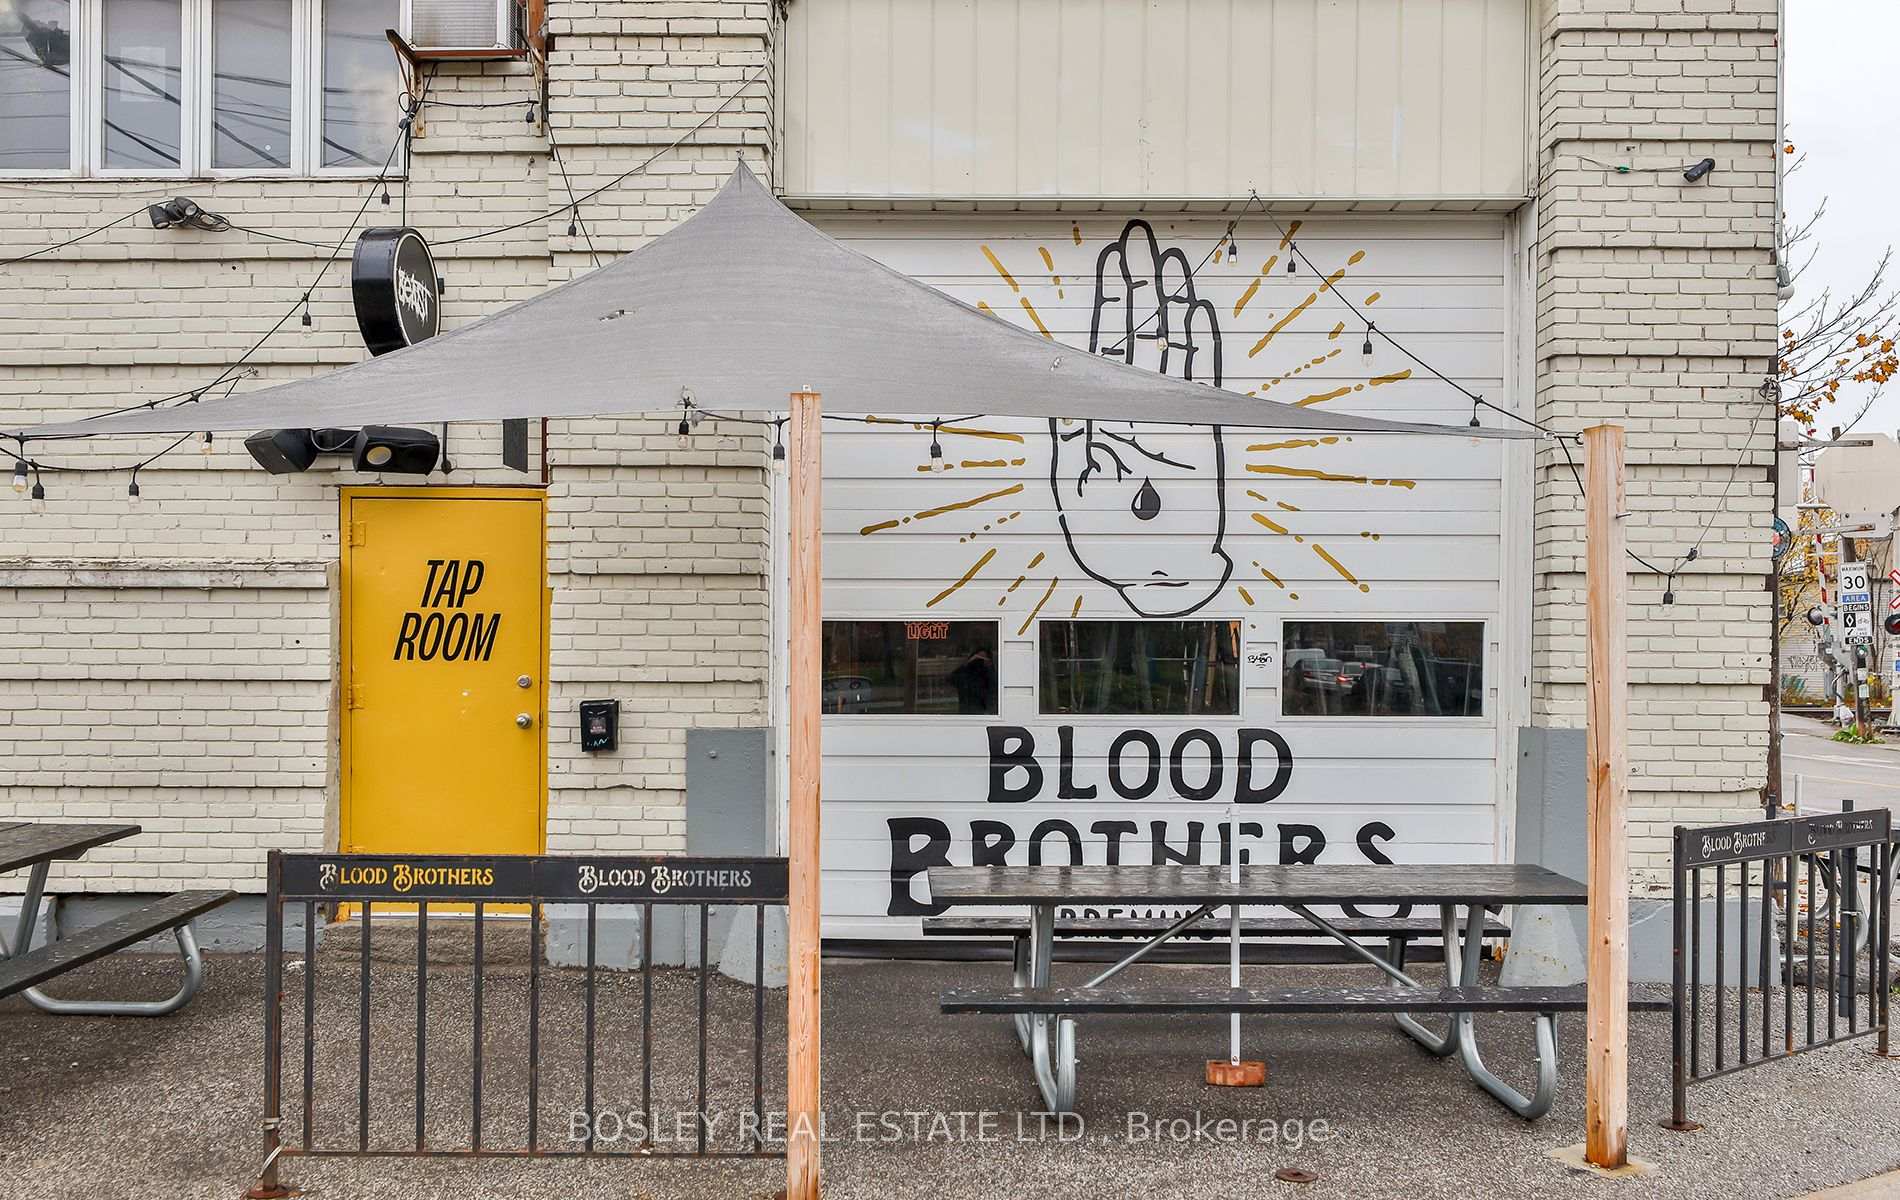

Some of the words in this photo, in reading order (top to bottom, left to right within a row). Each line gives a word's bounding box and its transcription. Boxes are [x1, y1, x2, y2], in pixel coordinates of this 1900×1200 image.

[421, 560, 485, 608] TAP
[1843, 575, 1865, 590] 30
[1843, 603, 1870, 612] BEGINS
[1845, 594, 1866, 603] AREA
[393, 612, 502, 662] ROOM
[907, 622, 949, 640] LIGHT
[1848, 636, 1870, 644] ENDS
[986, 726, 1293, 803] BLOOD
[1702, 836, 1732, 858] BLOOD
[319, 864, 388, 891] BLOOD
[393, 864, 495, 892] BROTHERS
[578, 866, 646, 893] BLOOD
[651, 866, 752, 893] BROTHERS
